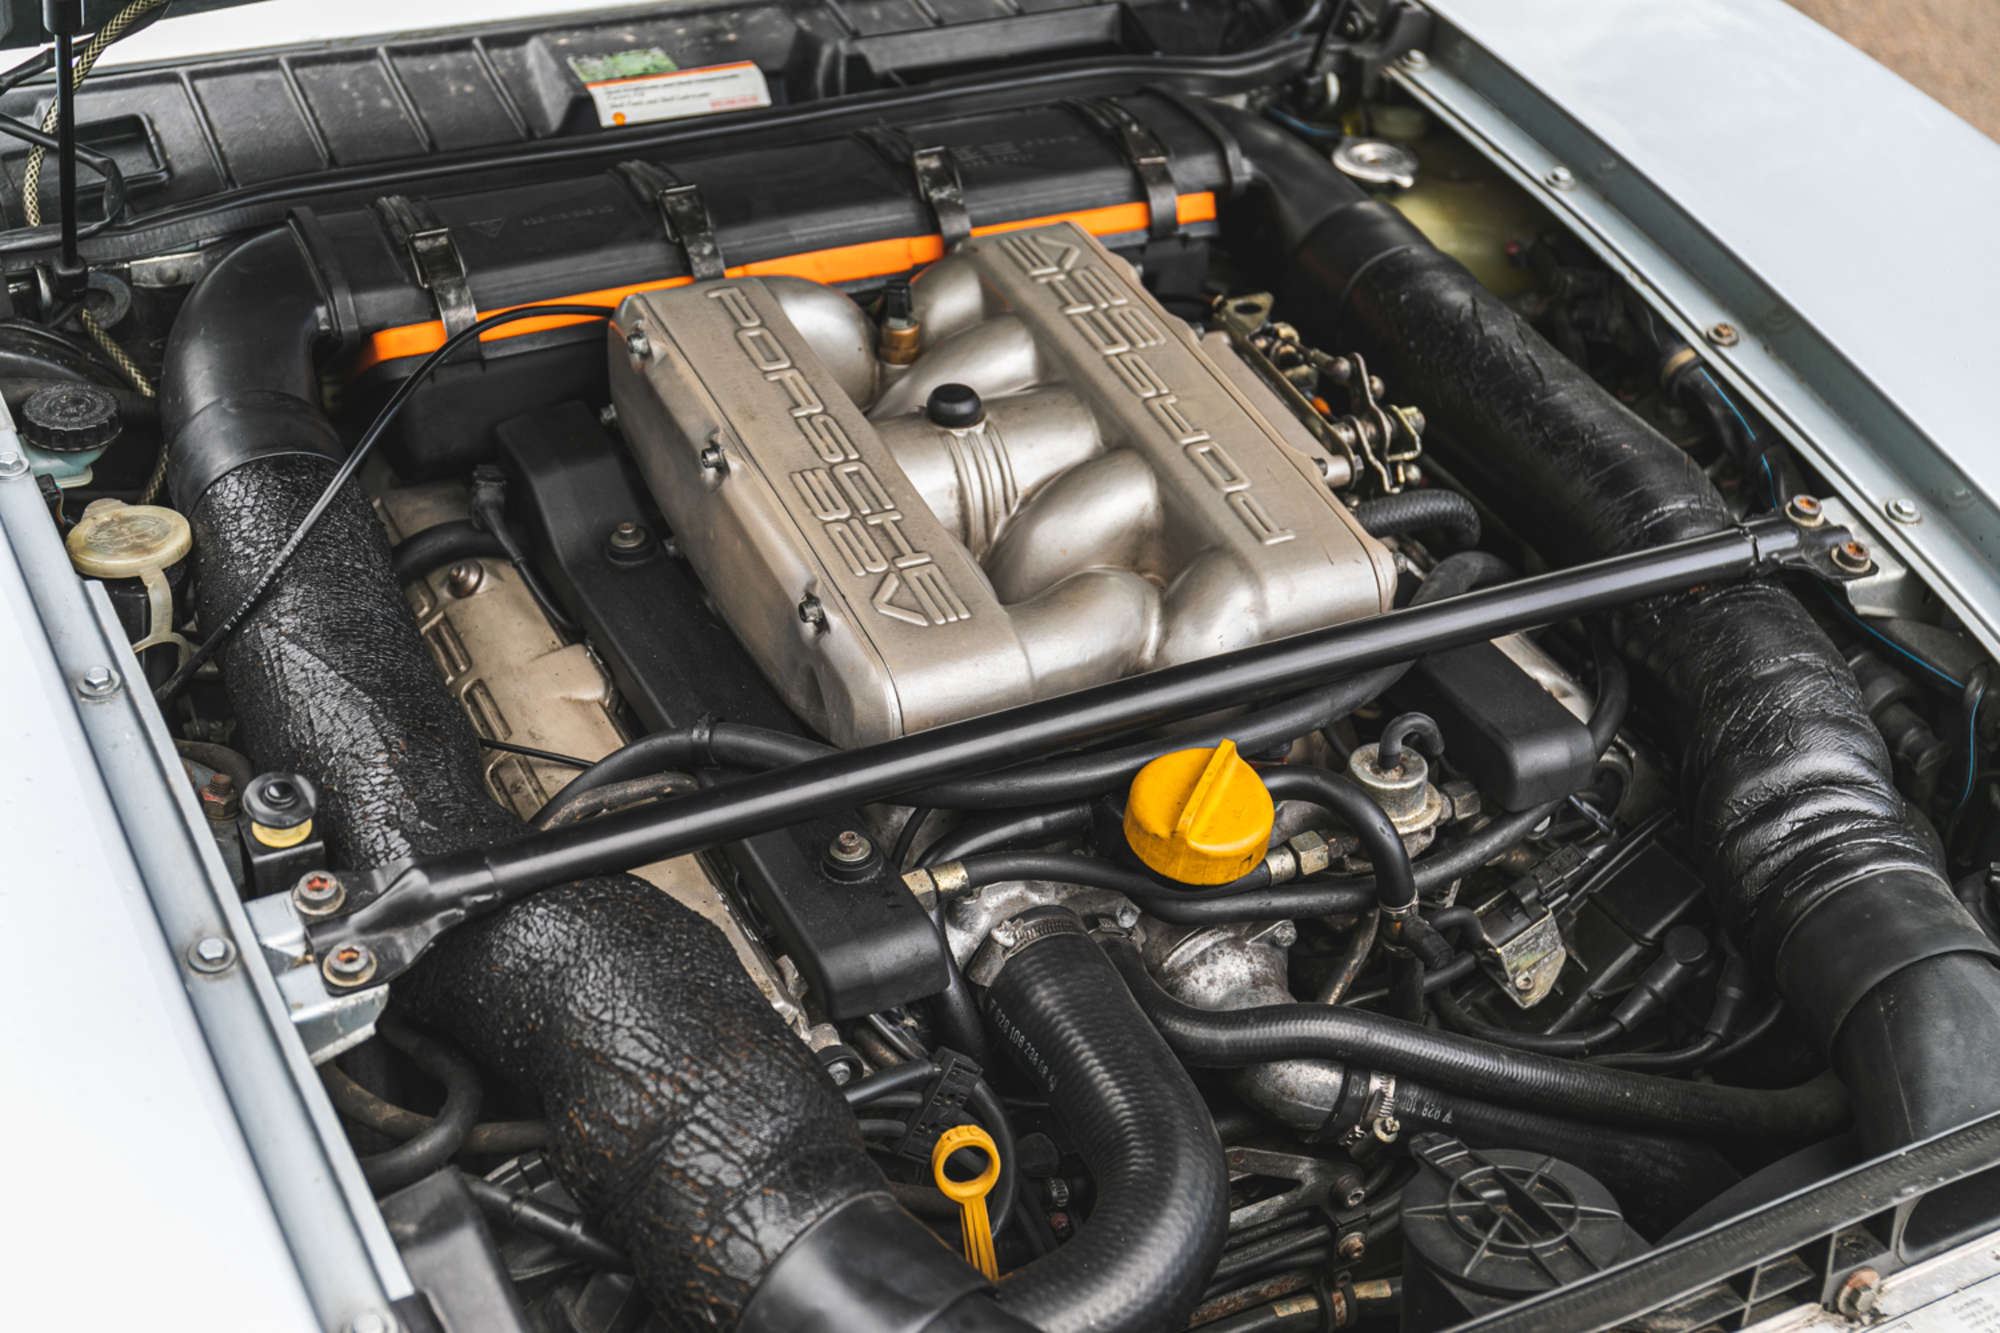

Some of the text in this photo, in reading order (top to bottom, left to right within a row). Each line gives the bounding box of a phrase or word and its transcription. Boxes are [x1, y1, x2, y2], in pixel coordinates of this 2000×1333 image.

[1001, 236, 1296, 545] PORSCHE
[1031, 236, 1167, 348] 32V
[706, 287, 971, 624] PORSCHE
[789, 467, 930, 627] 32V
